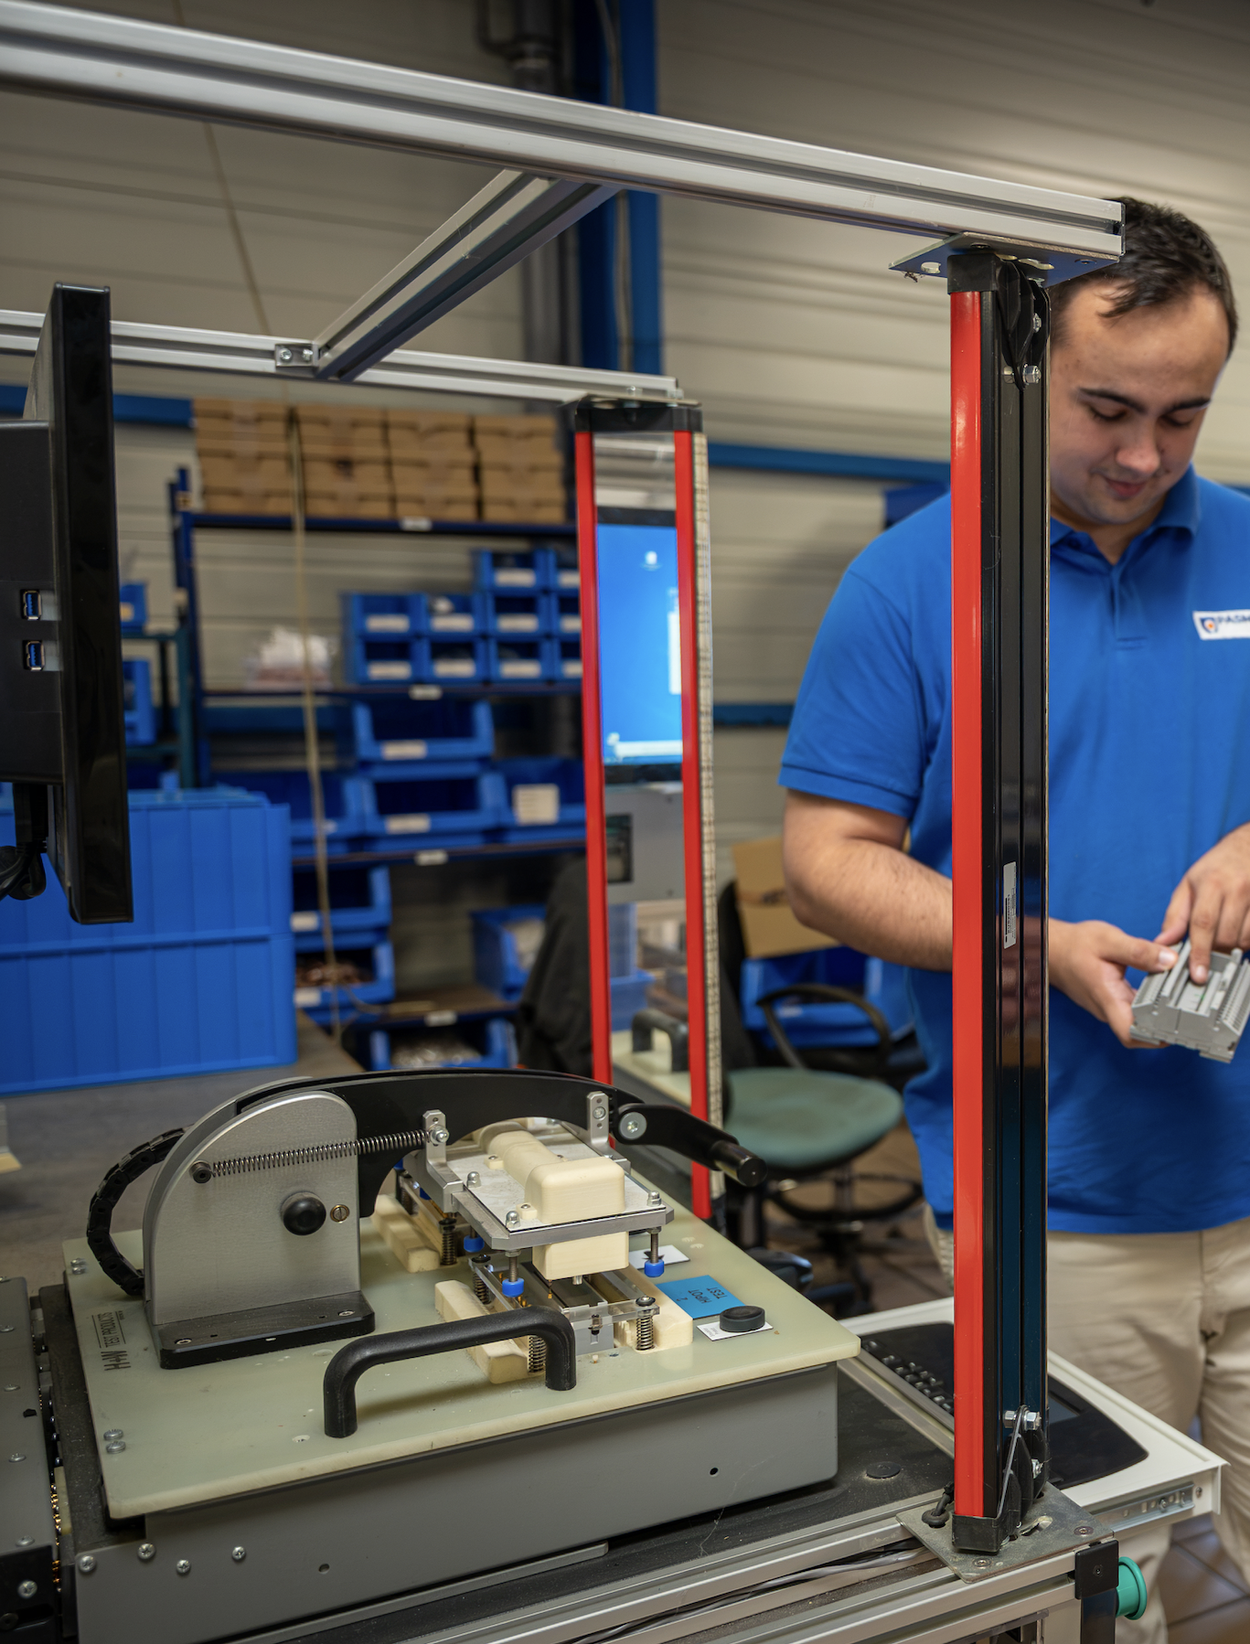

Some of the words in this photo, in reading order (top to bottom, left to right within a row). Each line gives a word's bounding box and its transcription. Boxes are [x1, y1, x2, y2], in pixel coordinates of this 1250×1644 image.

[688, 1289, 712, 1304] HIPOT
[706, 1287, 728, 1300] TEST
[103, 1335, 120, 1348] TEST
